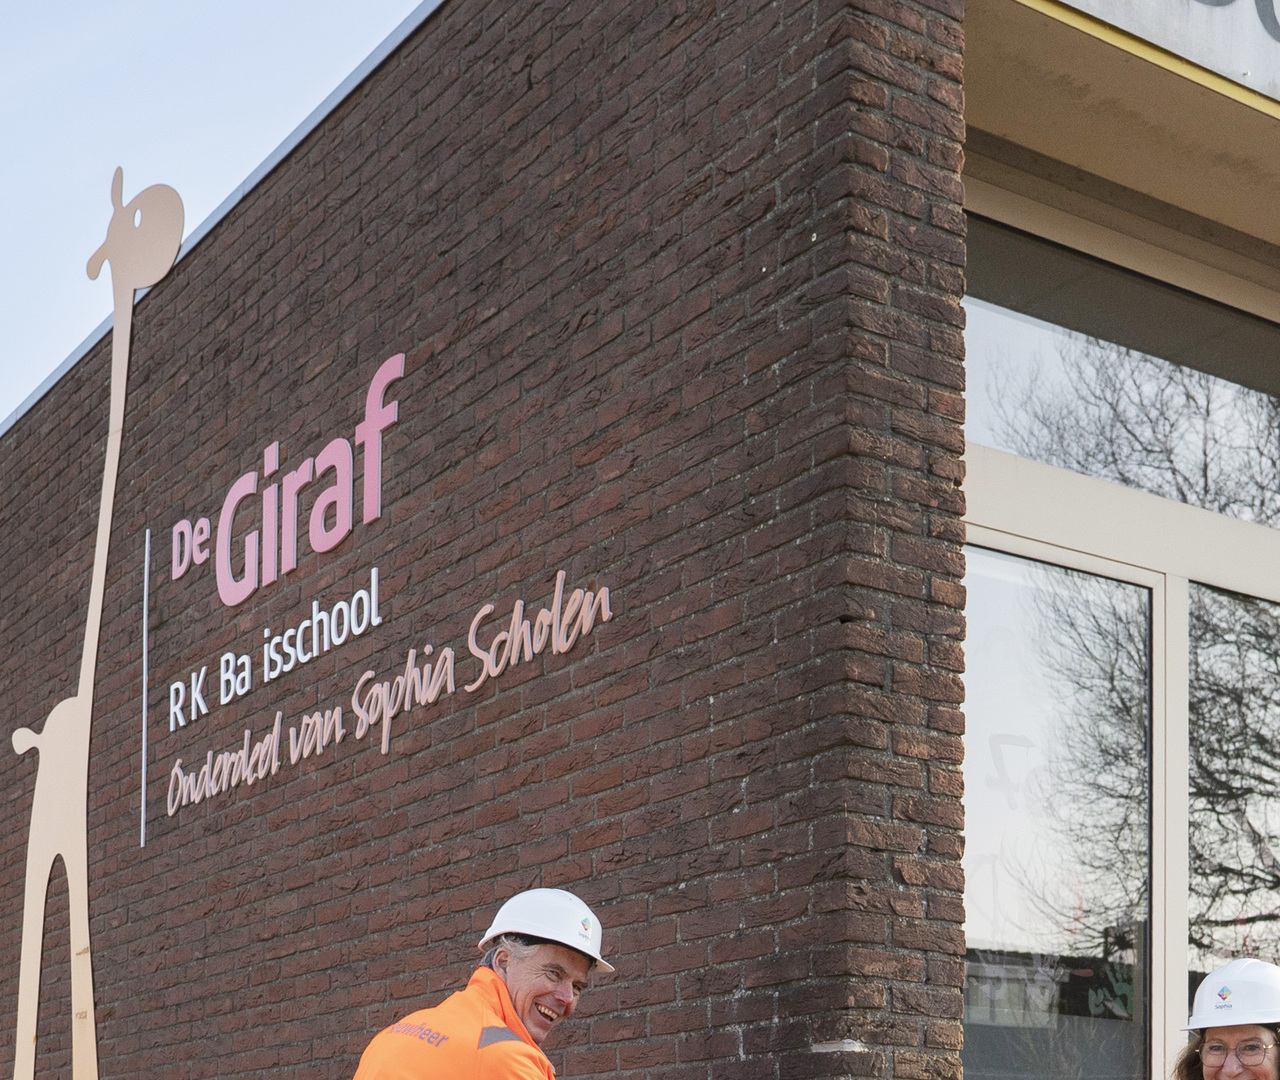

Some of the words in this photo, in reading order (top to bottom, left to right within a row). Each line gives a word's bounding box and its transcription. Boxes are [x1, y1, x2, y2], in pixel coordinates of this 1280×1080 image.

[172, 517, 211, 580] De
[216, 352, 406, 607] Giraf
[289, 707, 346, 765] van
[351, 644, 456, 755] Sophia
[464, 570, 613, 692] Scholen
